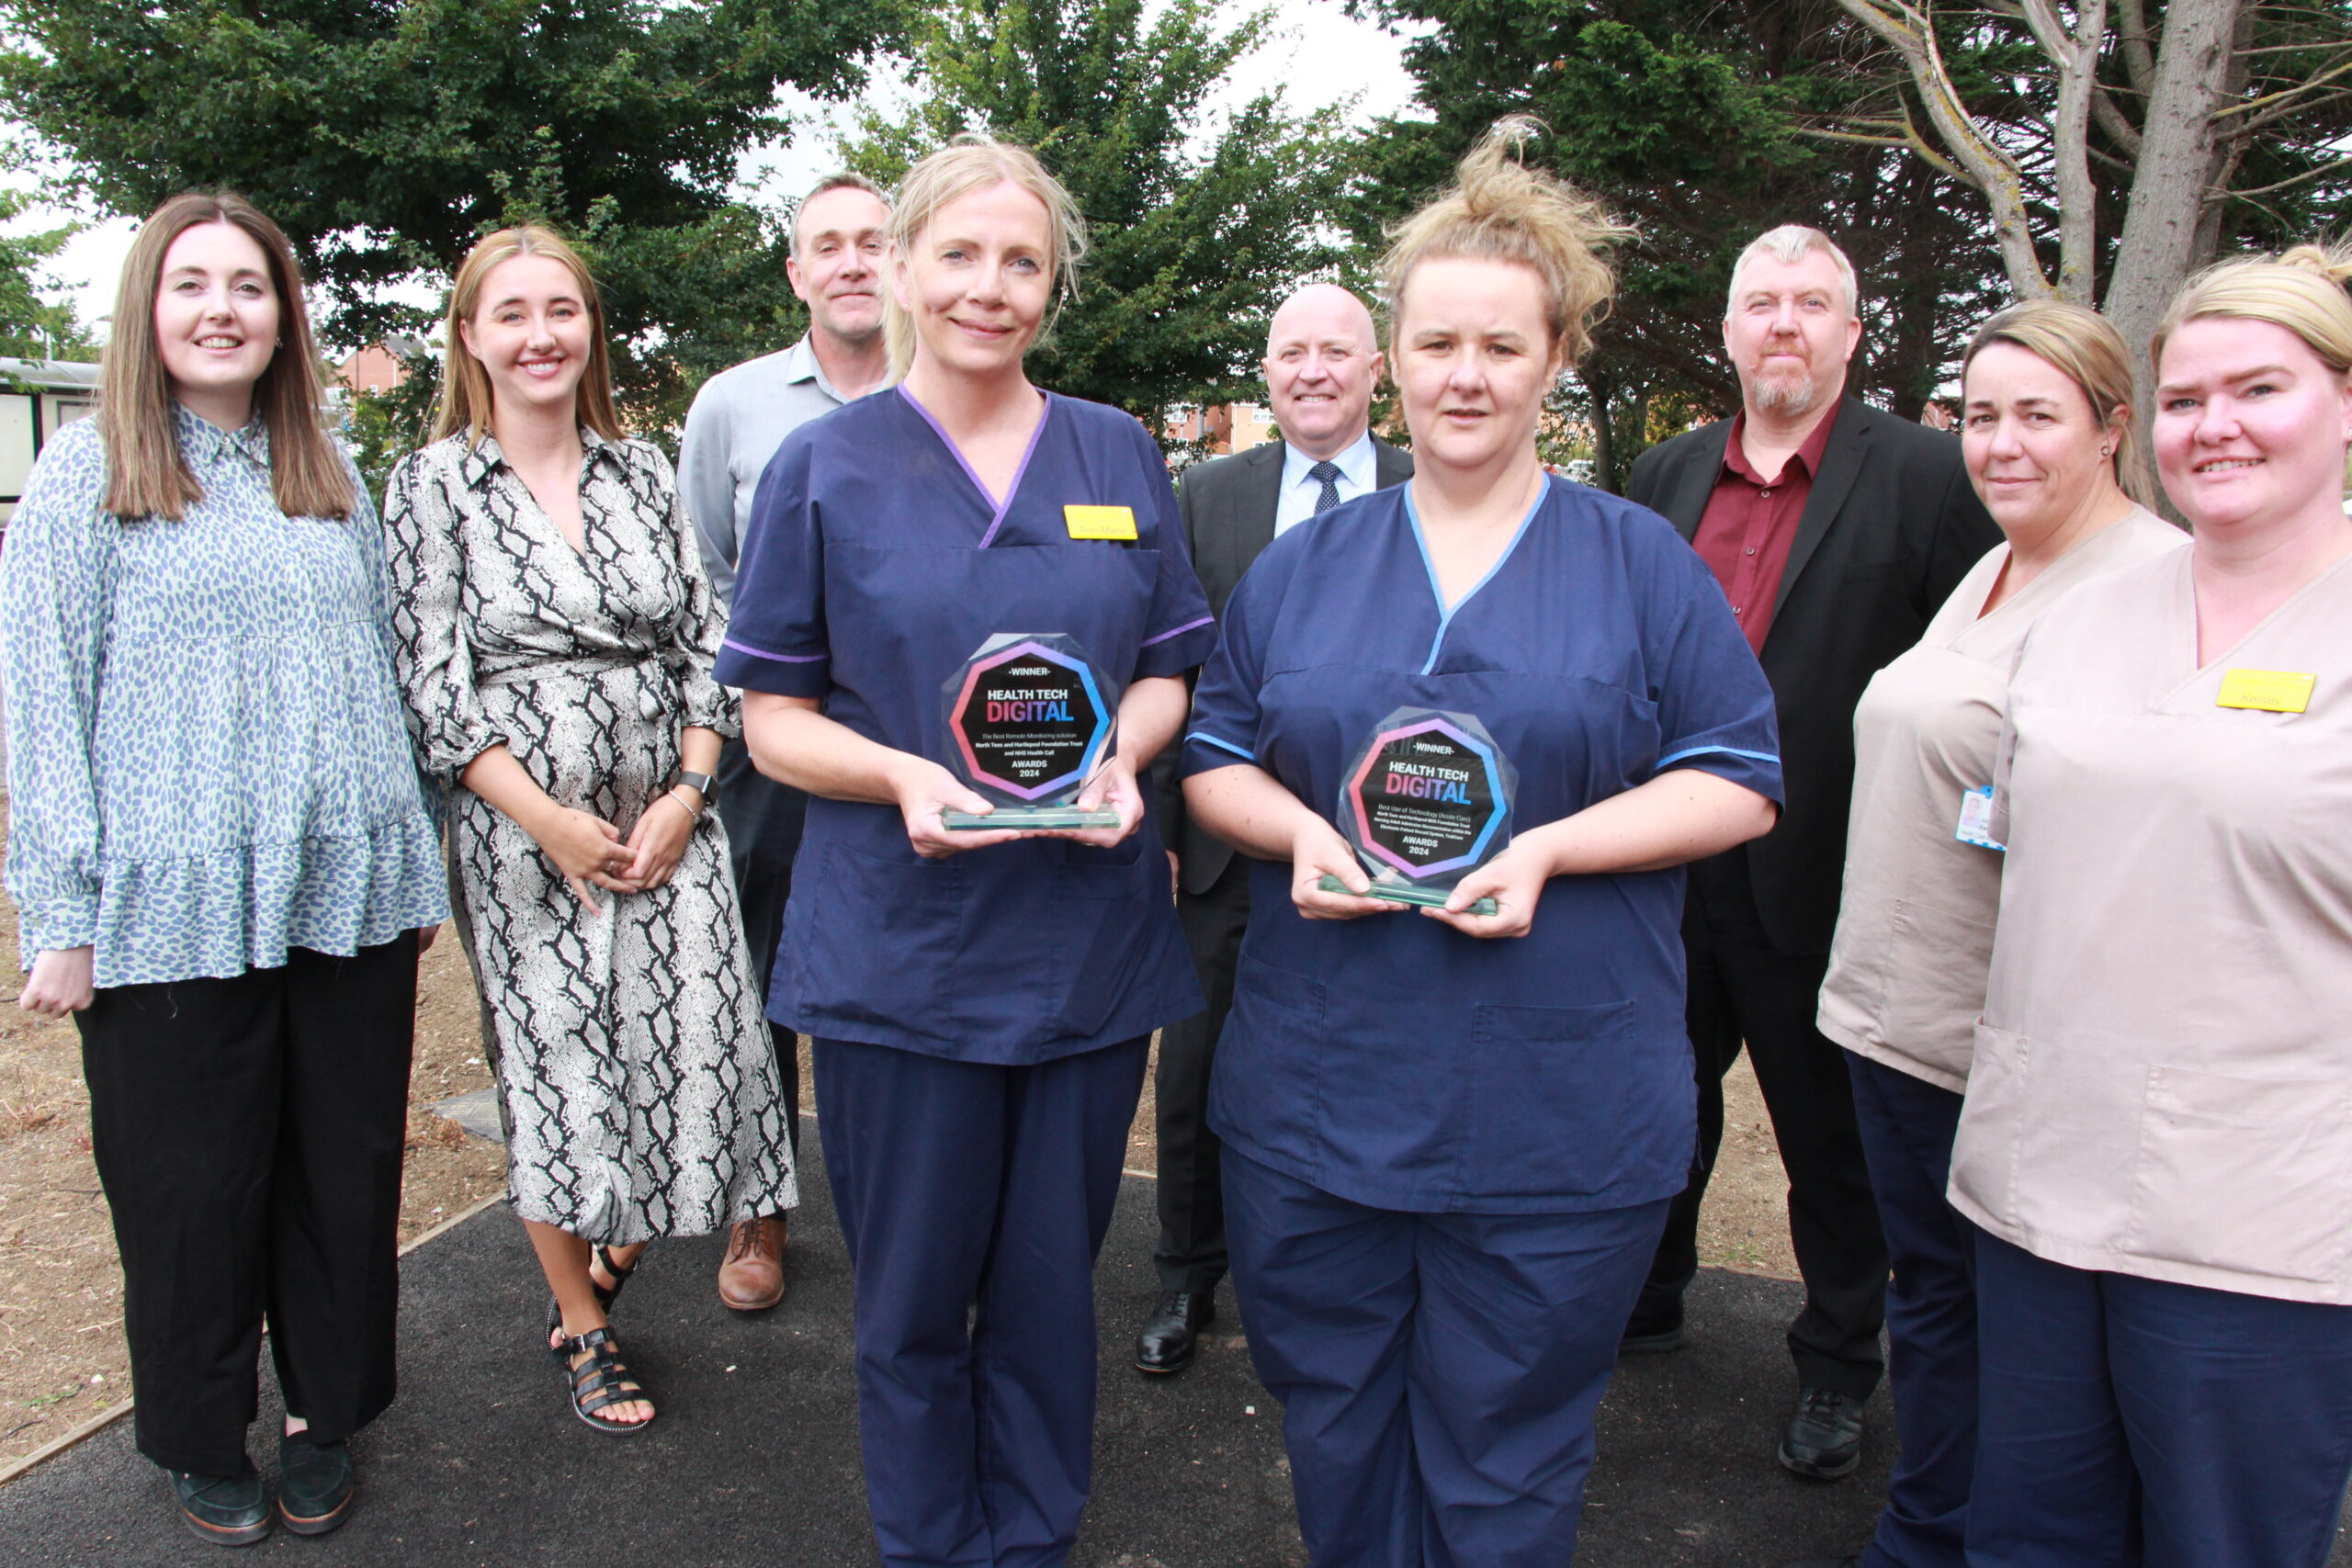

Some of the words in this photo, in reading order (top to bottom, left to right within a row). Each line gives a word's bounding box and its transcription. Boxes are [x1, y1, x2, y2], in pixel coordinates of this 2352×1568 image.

[988, 690, 1034, 700] HEALTH
[1036, 689, 1068, 699] TECH
[987, 701, 1074, 722] DIGITAL
[1012, 760, 1047, 768] AWARDS
[1019, 770, 1040, 778] 2024
[1388, 761, 1435, 777] HEALTH
[1437, 767, 1469, 782] TECH
[1385, 773, 1472, 805] DIGITAL
[1408, 807, 1438, 818] Technology
[1402, 836, 1439, 848] AWARDS
[1408, 846, 1430, 856] 2024
